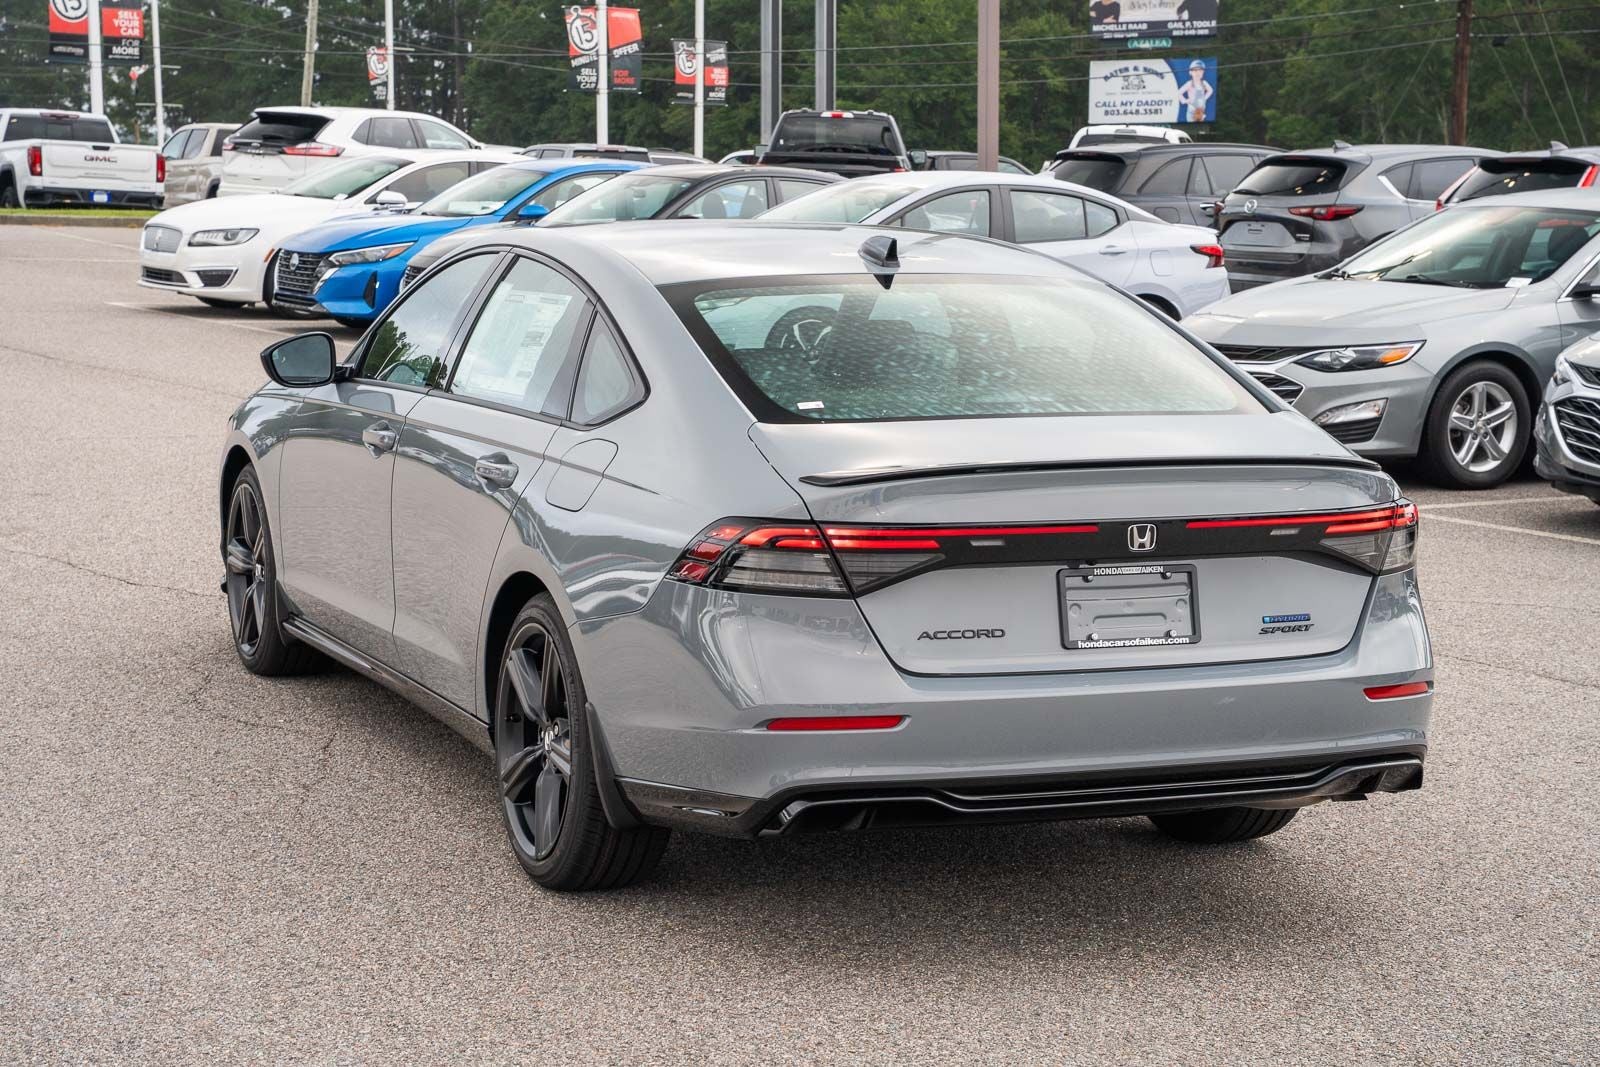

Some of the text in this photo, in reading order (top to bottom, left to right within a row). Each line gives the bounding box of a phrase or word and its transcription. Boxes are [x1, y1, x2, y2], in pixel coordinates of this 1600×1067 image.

[117, 10, 139, 20] SELL
[113, 18, 140, 28] YOUR
[1092, 24, 1127, 32] MICHELLE
[120, 27, 140, 36] CAR
[575, 22, 594, 45] 15
[112, 46, 140, 55] MORE
[612, 43, 639, 58] OFFER
[580, 68, 597, 76] SELL
[84, 155, 118, 163] GMC
[1094, 567, 1122, 576] HONDA
[1141, 565, 1164, 574] AIKEN
[917, 628, 1006, 640] ACCORD
[1259, 624, 1314, 635] SPORT
[1078, 637, 1190, 649] hondacarsofaiken.com
